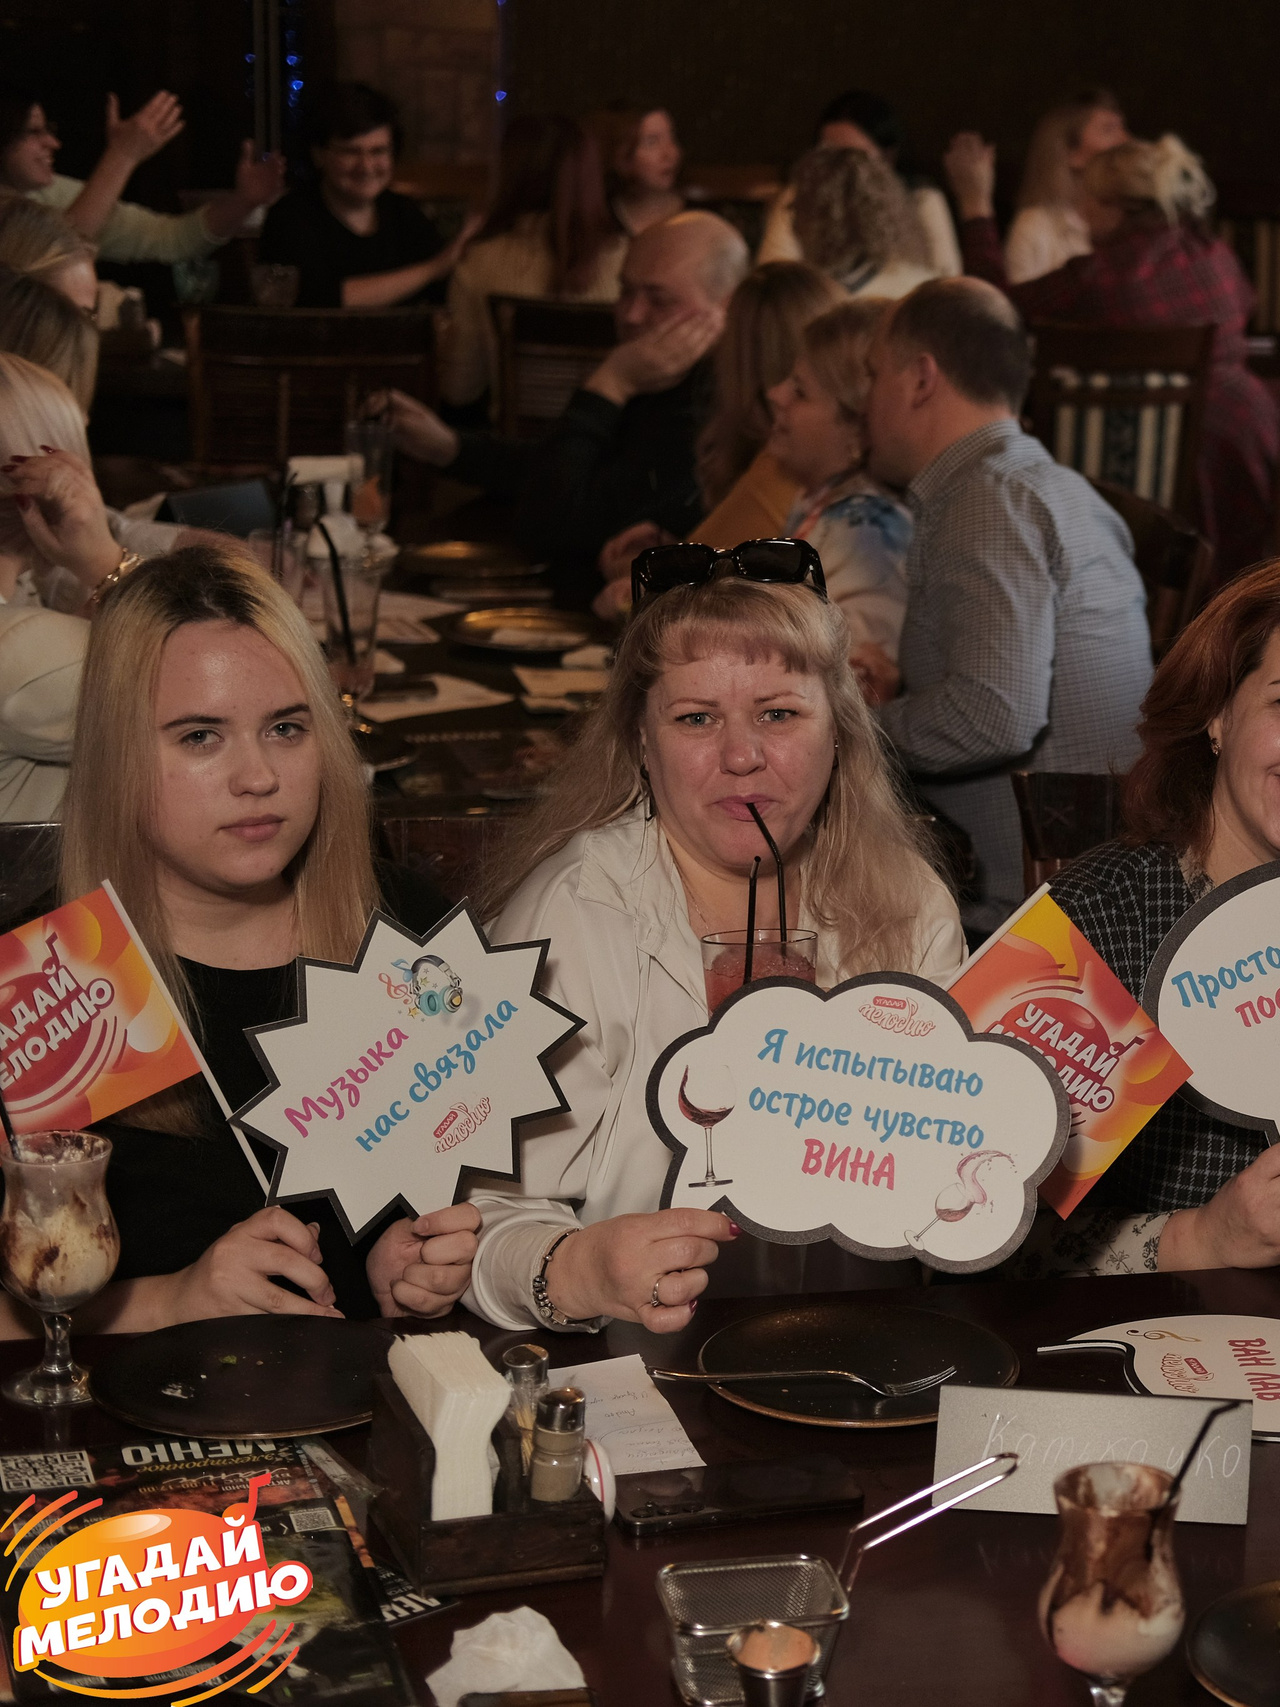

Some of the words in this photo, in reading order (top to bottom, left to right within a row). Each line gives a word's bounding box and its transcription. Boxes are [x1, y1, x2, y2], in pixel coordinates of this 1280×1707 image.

[757, 1028, 789, 1064] Я
[795, 1041, 984, 1098] испытываю
[1015, 1003, 1118, 1078] УГАДАЙ
[284, 1027, 409, 1138] Музыка
[355, 1101, 411, 1153] нас
[408, 999, 519, 1105] связала
[748, 1086, 853, 1129] острое
[863, 1105, 985, 1150] чувство
[801, 1138, 896, 1191] ВИНА
[1227, 1337, 1277, 1368] ВАН
